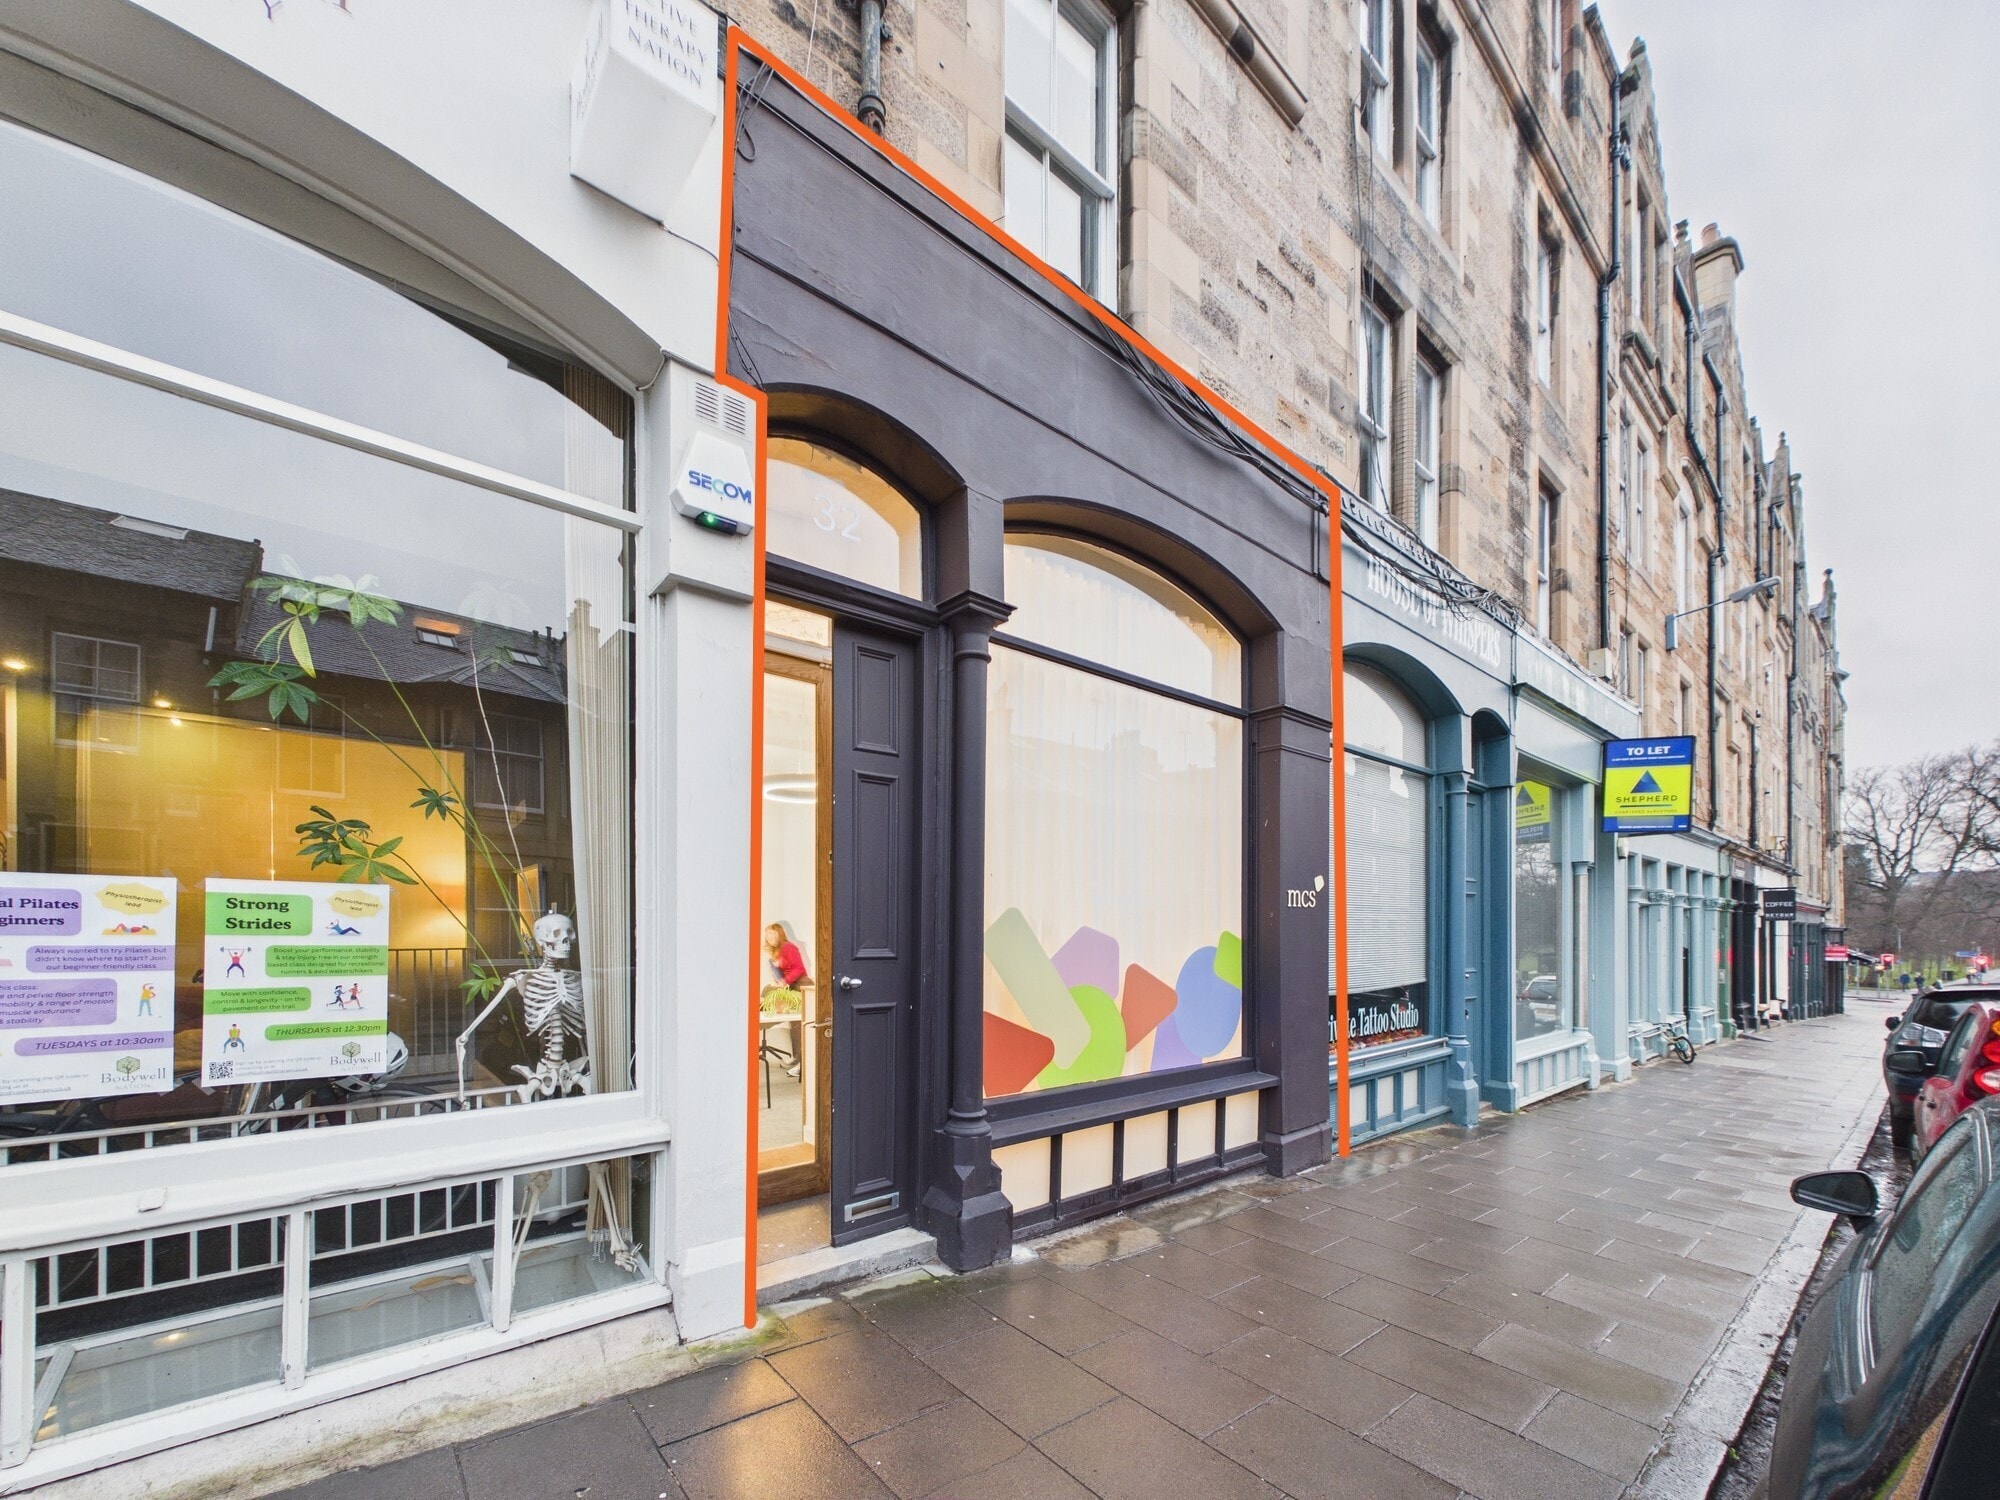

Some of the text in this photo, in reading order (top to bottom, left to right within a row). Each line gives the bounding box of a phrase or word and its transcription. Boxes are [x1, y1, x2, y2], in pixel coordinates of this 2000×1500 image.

[648, 0, 697, 37] TIVE
[625, 0, 707, 64] THERAPY
[629, 26, 701, 87] NATION
[688, 469, 752, 504] SECOM
[812, 493, 862, 543] 32
[1367, 560, 1420, 617] HOUSE
[1441, 602, 1501, 668] WHISPERS
[1626, 746, 1671, 756] TO LET
[1616, 795, 1678, 803] SHEPHERD
[105, 890, 163, 904] Physiotherapist
[334, 896, 378, 908] Physiotherapist
[1287, 889, 1316, 908] mcs
[19, 898, 79, 910] Pilates
[226, 897, 289, 912] Strong
[0, 915, 65, 927] ginners
[225, 918, 291, 930] Strides
[35, 948, 66, 956] Always
[63, 963, 135, 971] beginner-friendly
[306, 961, 337, 969] designed
[78, 990, 114, 998] strength
[0, 1000, 34, 1008] mobility
[6, 1017, 44, 1025] stability
[1358, 1005, 1389, 1036] Tattoo
[1390, 1001, 1419, 1032] Studio
[276, 1026, 331, 1036] THURSDAYS
[344, 1024, 381, 1034] 12:30pm
[35, 1040, 97, 1050] TUESDAYS
[115, 1037, 165, 1046] 10:30am
[330, 1052, 381, 1066] Bodywell
[101, 1068, 166, 1083] Bodywell
